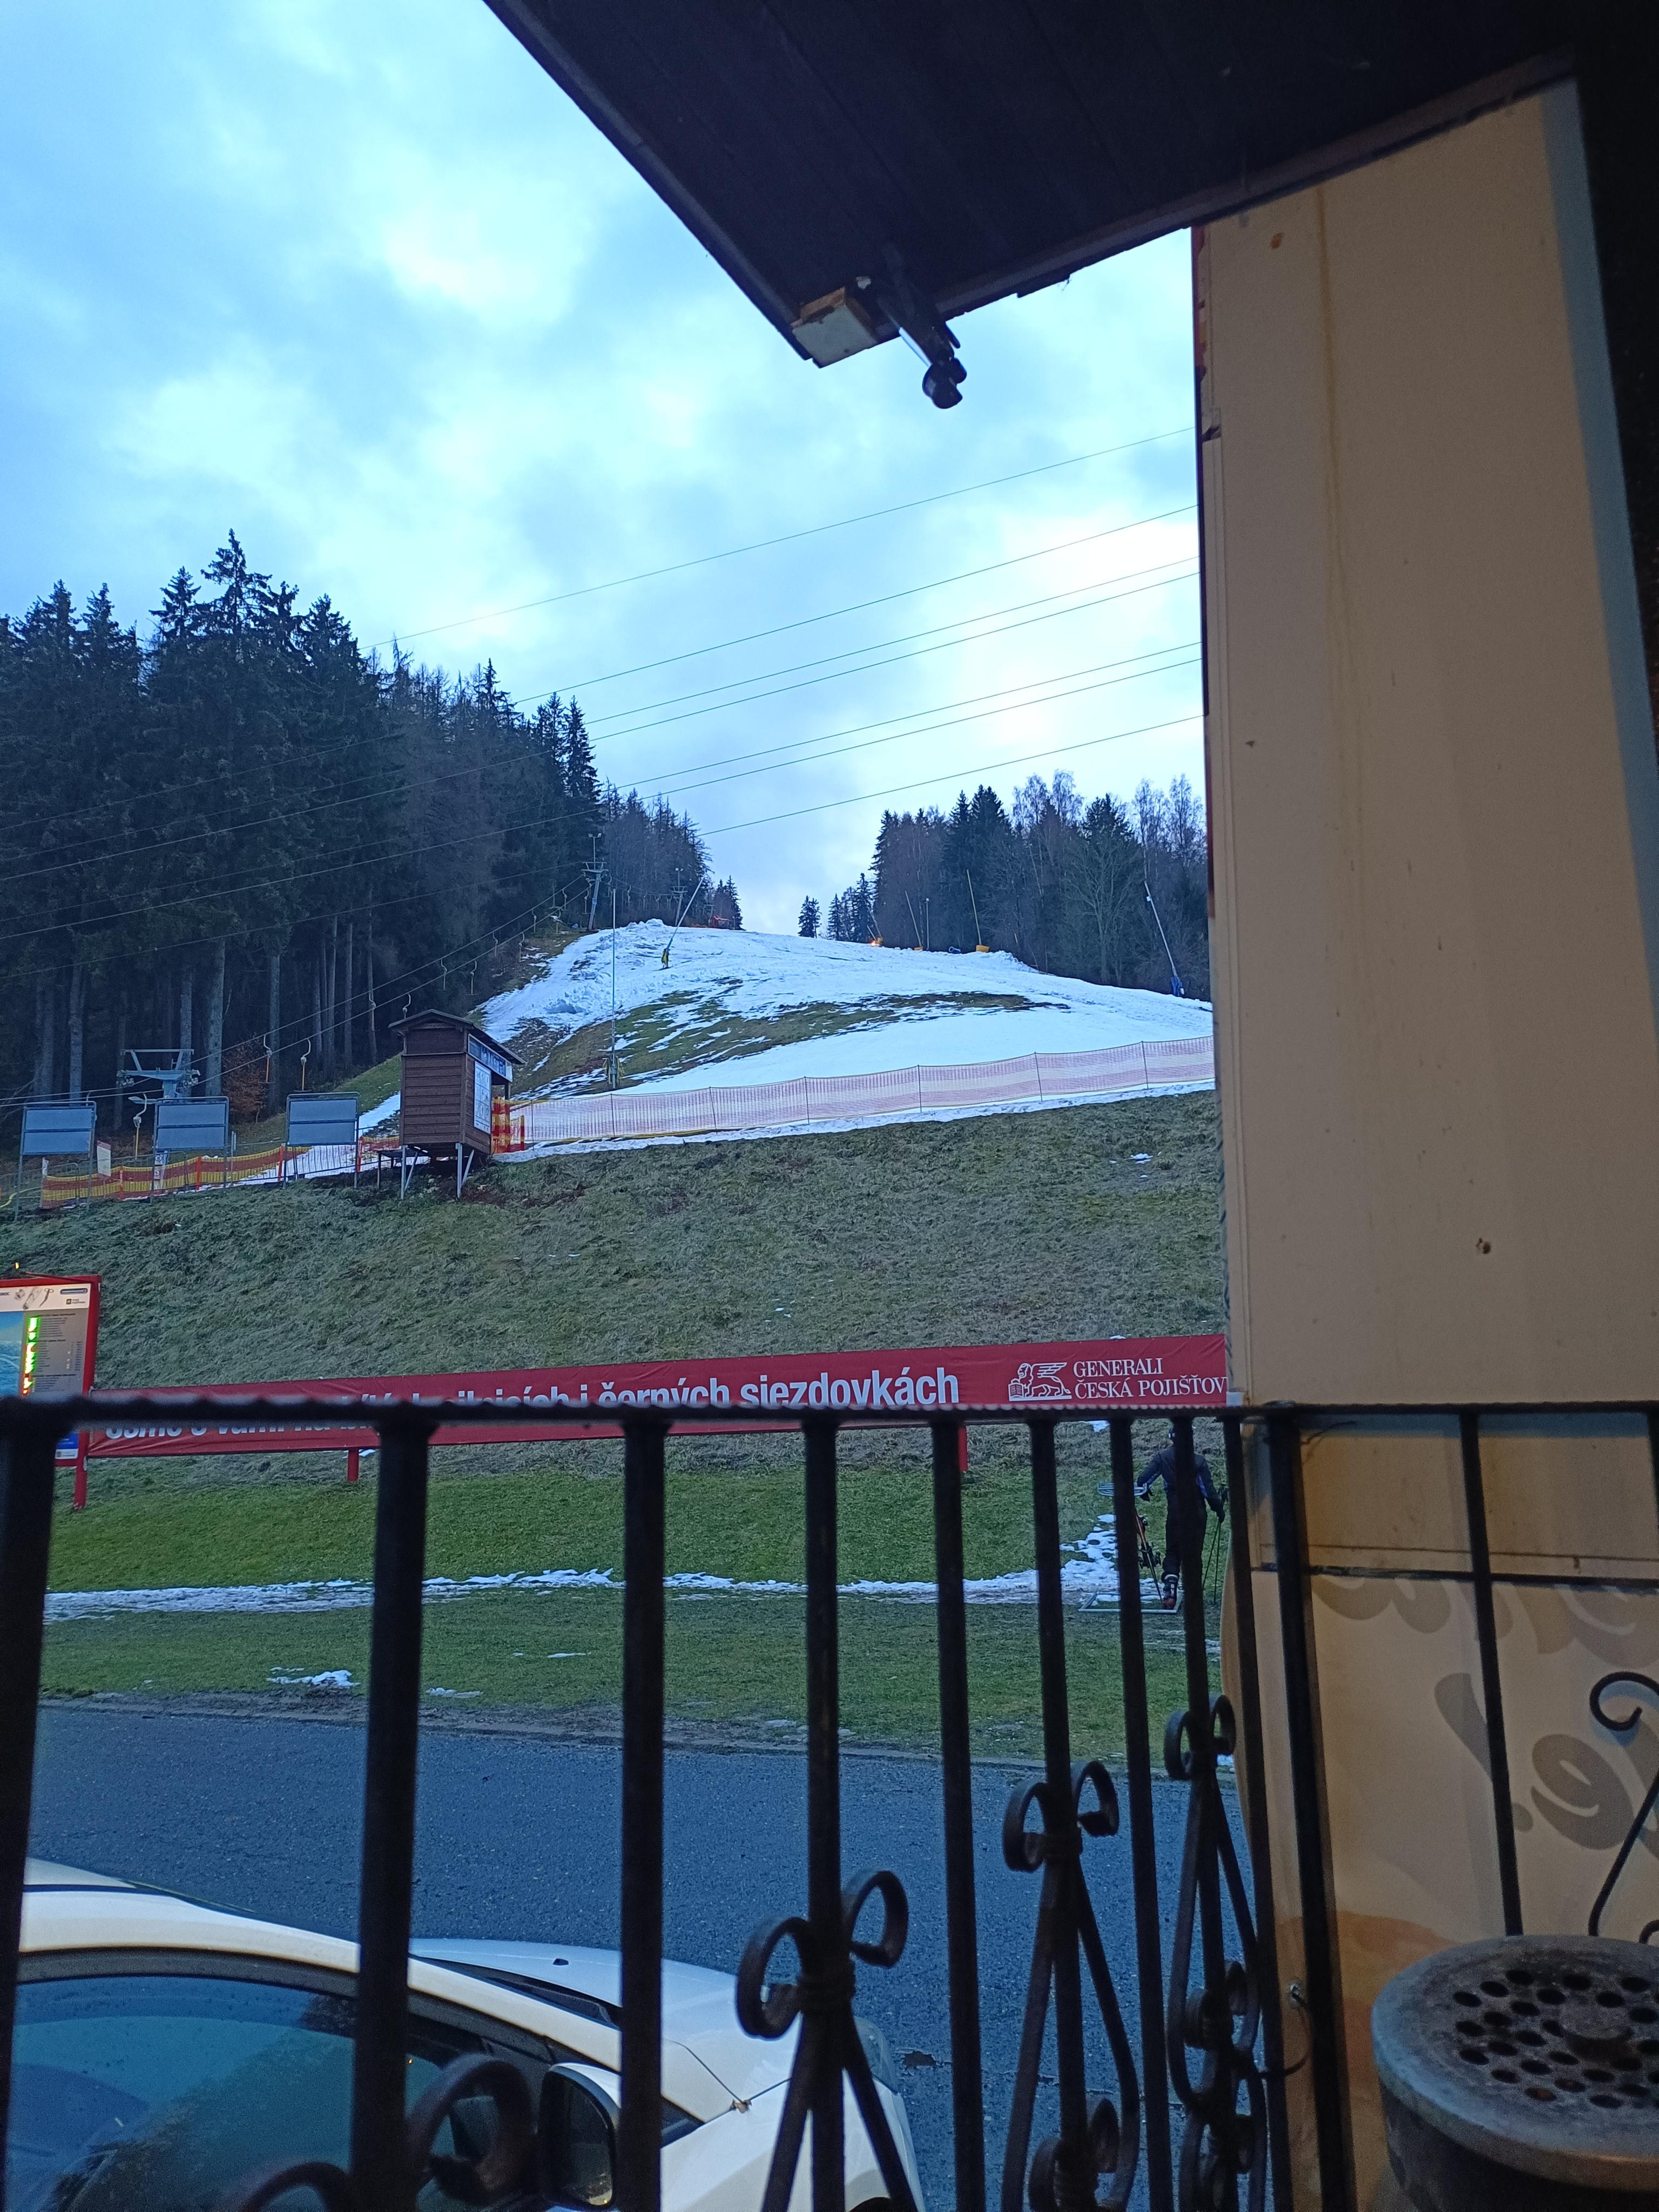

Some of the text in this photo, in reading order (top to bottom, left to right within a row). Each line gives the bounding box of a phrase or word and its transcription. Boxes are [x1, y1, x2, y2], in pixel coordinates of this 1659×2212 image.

[1073, 1358, 1163, 1378] GENERALI
[740, 1367, 959, 1407] sjezdovkách
[1074, 1377, 1134, 1399] ČESKÁ
